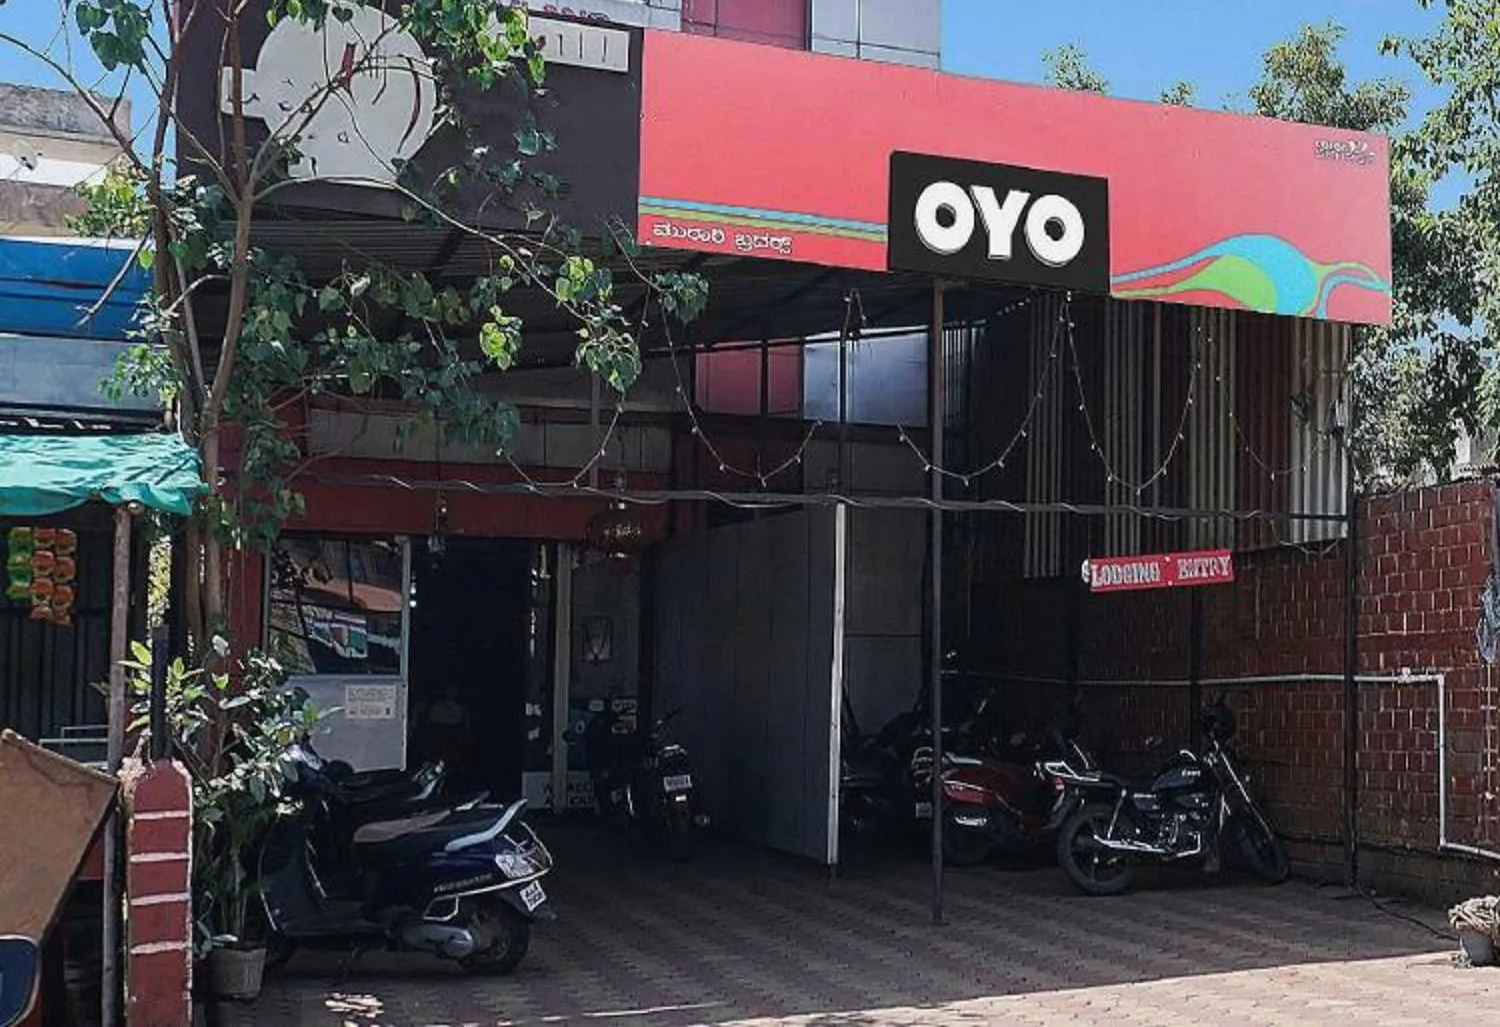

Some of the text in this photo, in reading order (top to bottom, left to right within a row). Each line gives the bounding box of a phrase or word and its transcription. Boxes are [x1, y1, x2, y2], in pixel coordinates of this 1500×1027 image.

[914, 181, 1085, 269] OYO
[1091, 555, 1231, 588] LODGING ENTRY
